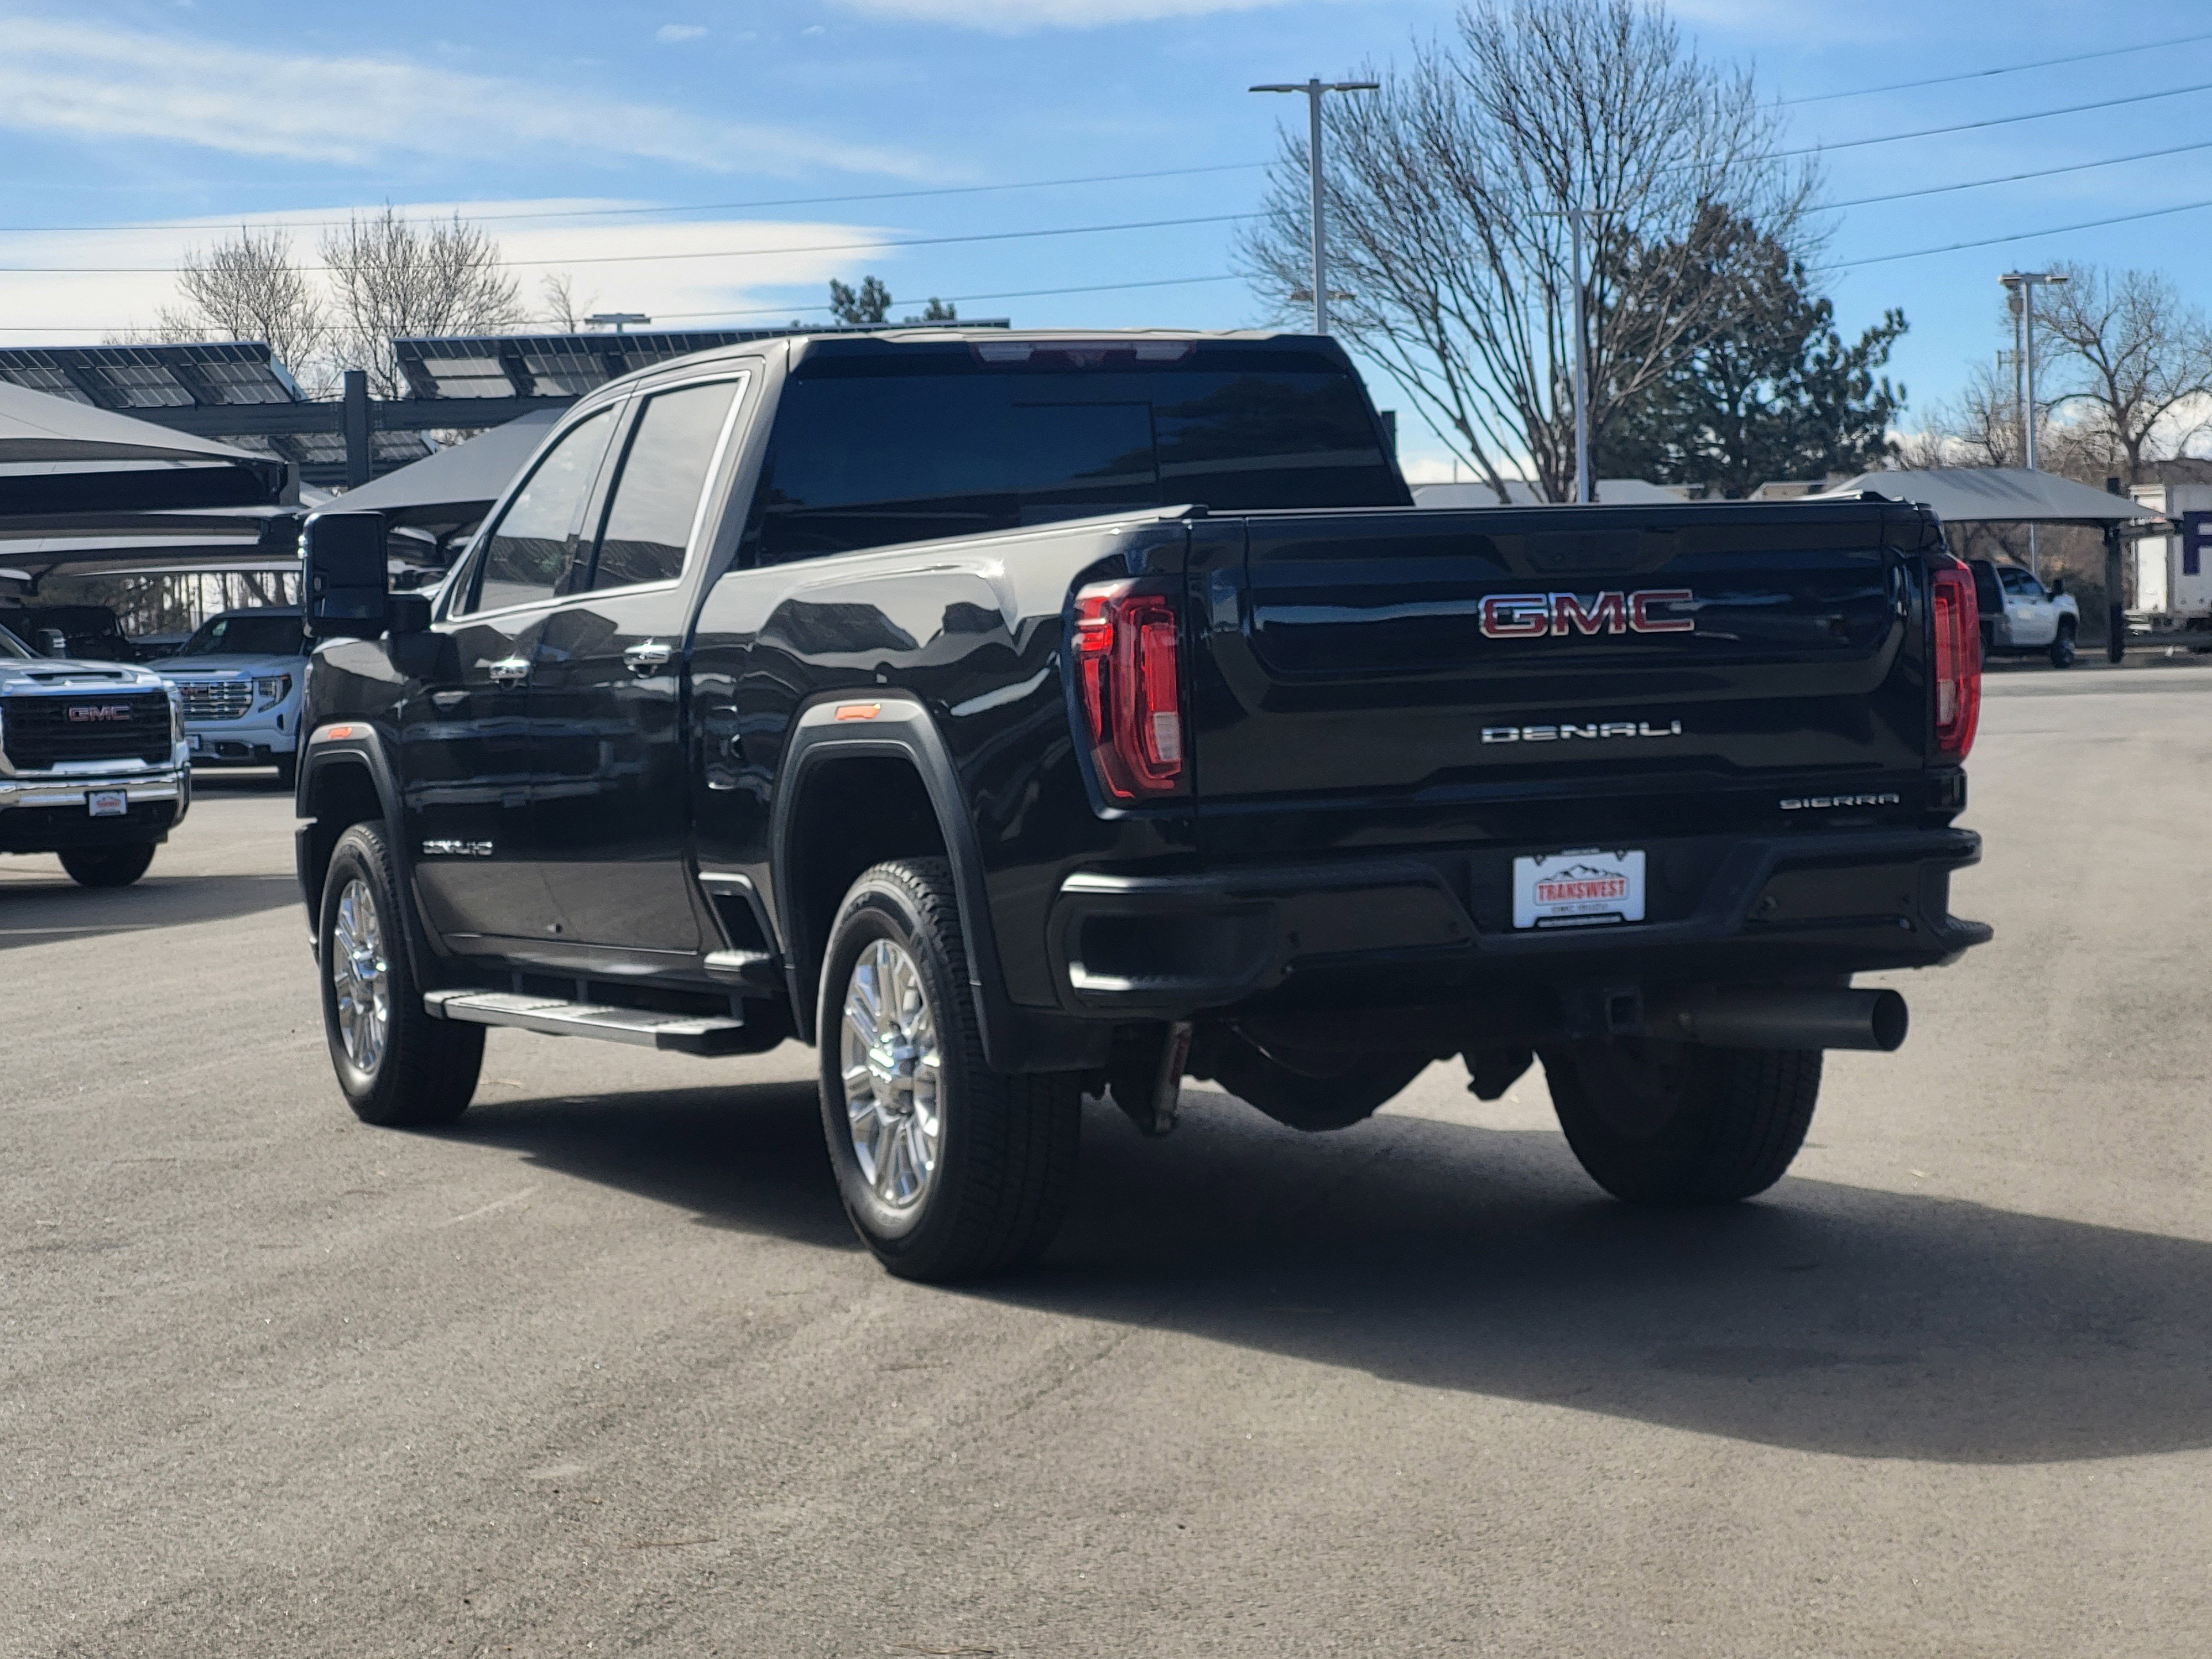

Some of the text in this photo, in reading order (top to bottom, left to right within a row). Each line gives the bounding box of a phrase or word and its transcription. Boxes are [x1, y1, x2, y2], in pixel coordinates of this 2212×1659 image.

[1478, 589, 1695, 638] GMC
[69, 705, 131, 721] GMC
[1481, 720, 1682, 743] DENALI
[1780, 792, 1900, 810] SIERRA
[1538, 879, 1626, 902] TRANSWEST
